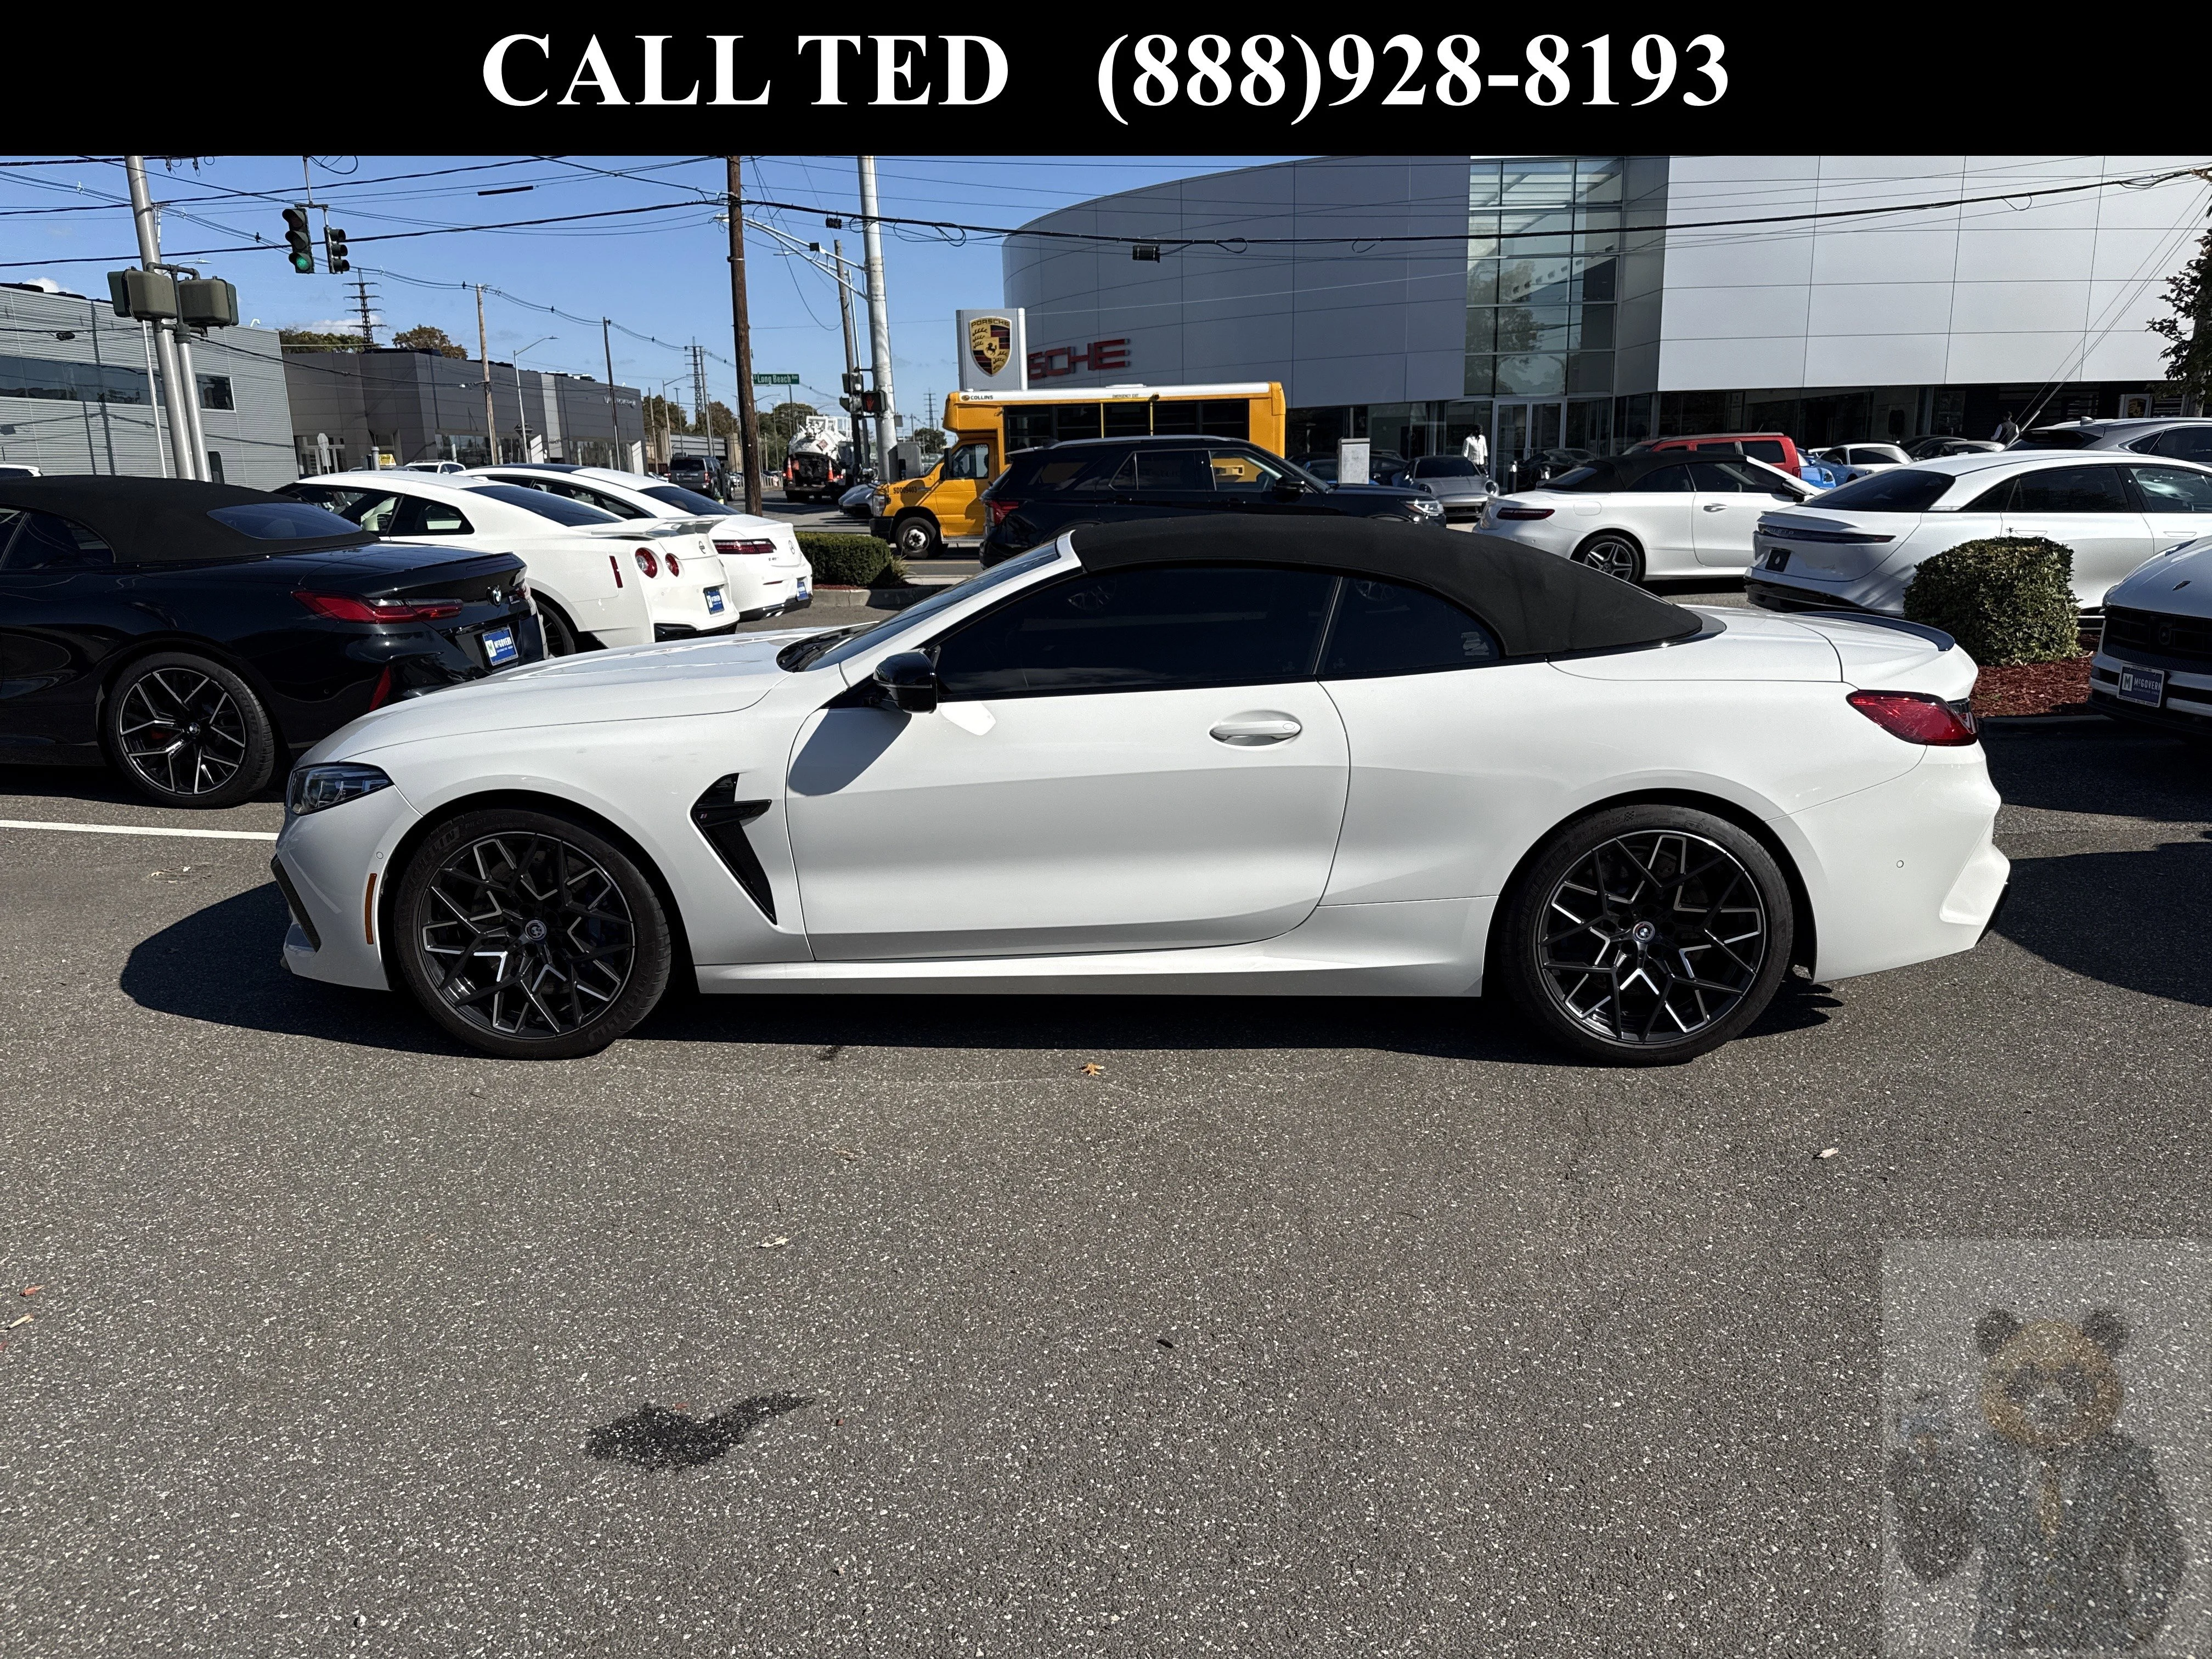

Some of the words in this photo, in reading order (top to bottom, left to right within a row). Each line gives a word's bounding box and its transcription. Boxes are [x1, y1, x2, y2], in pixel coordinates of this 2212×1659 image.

[971, 319, 1010, 328] PORSCHE
[757, 374, 772, 385] Long
[772, 374, 791, 383] Beach
